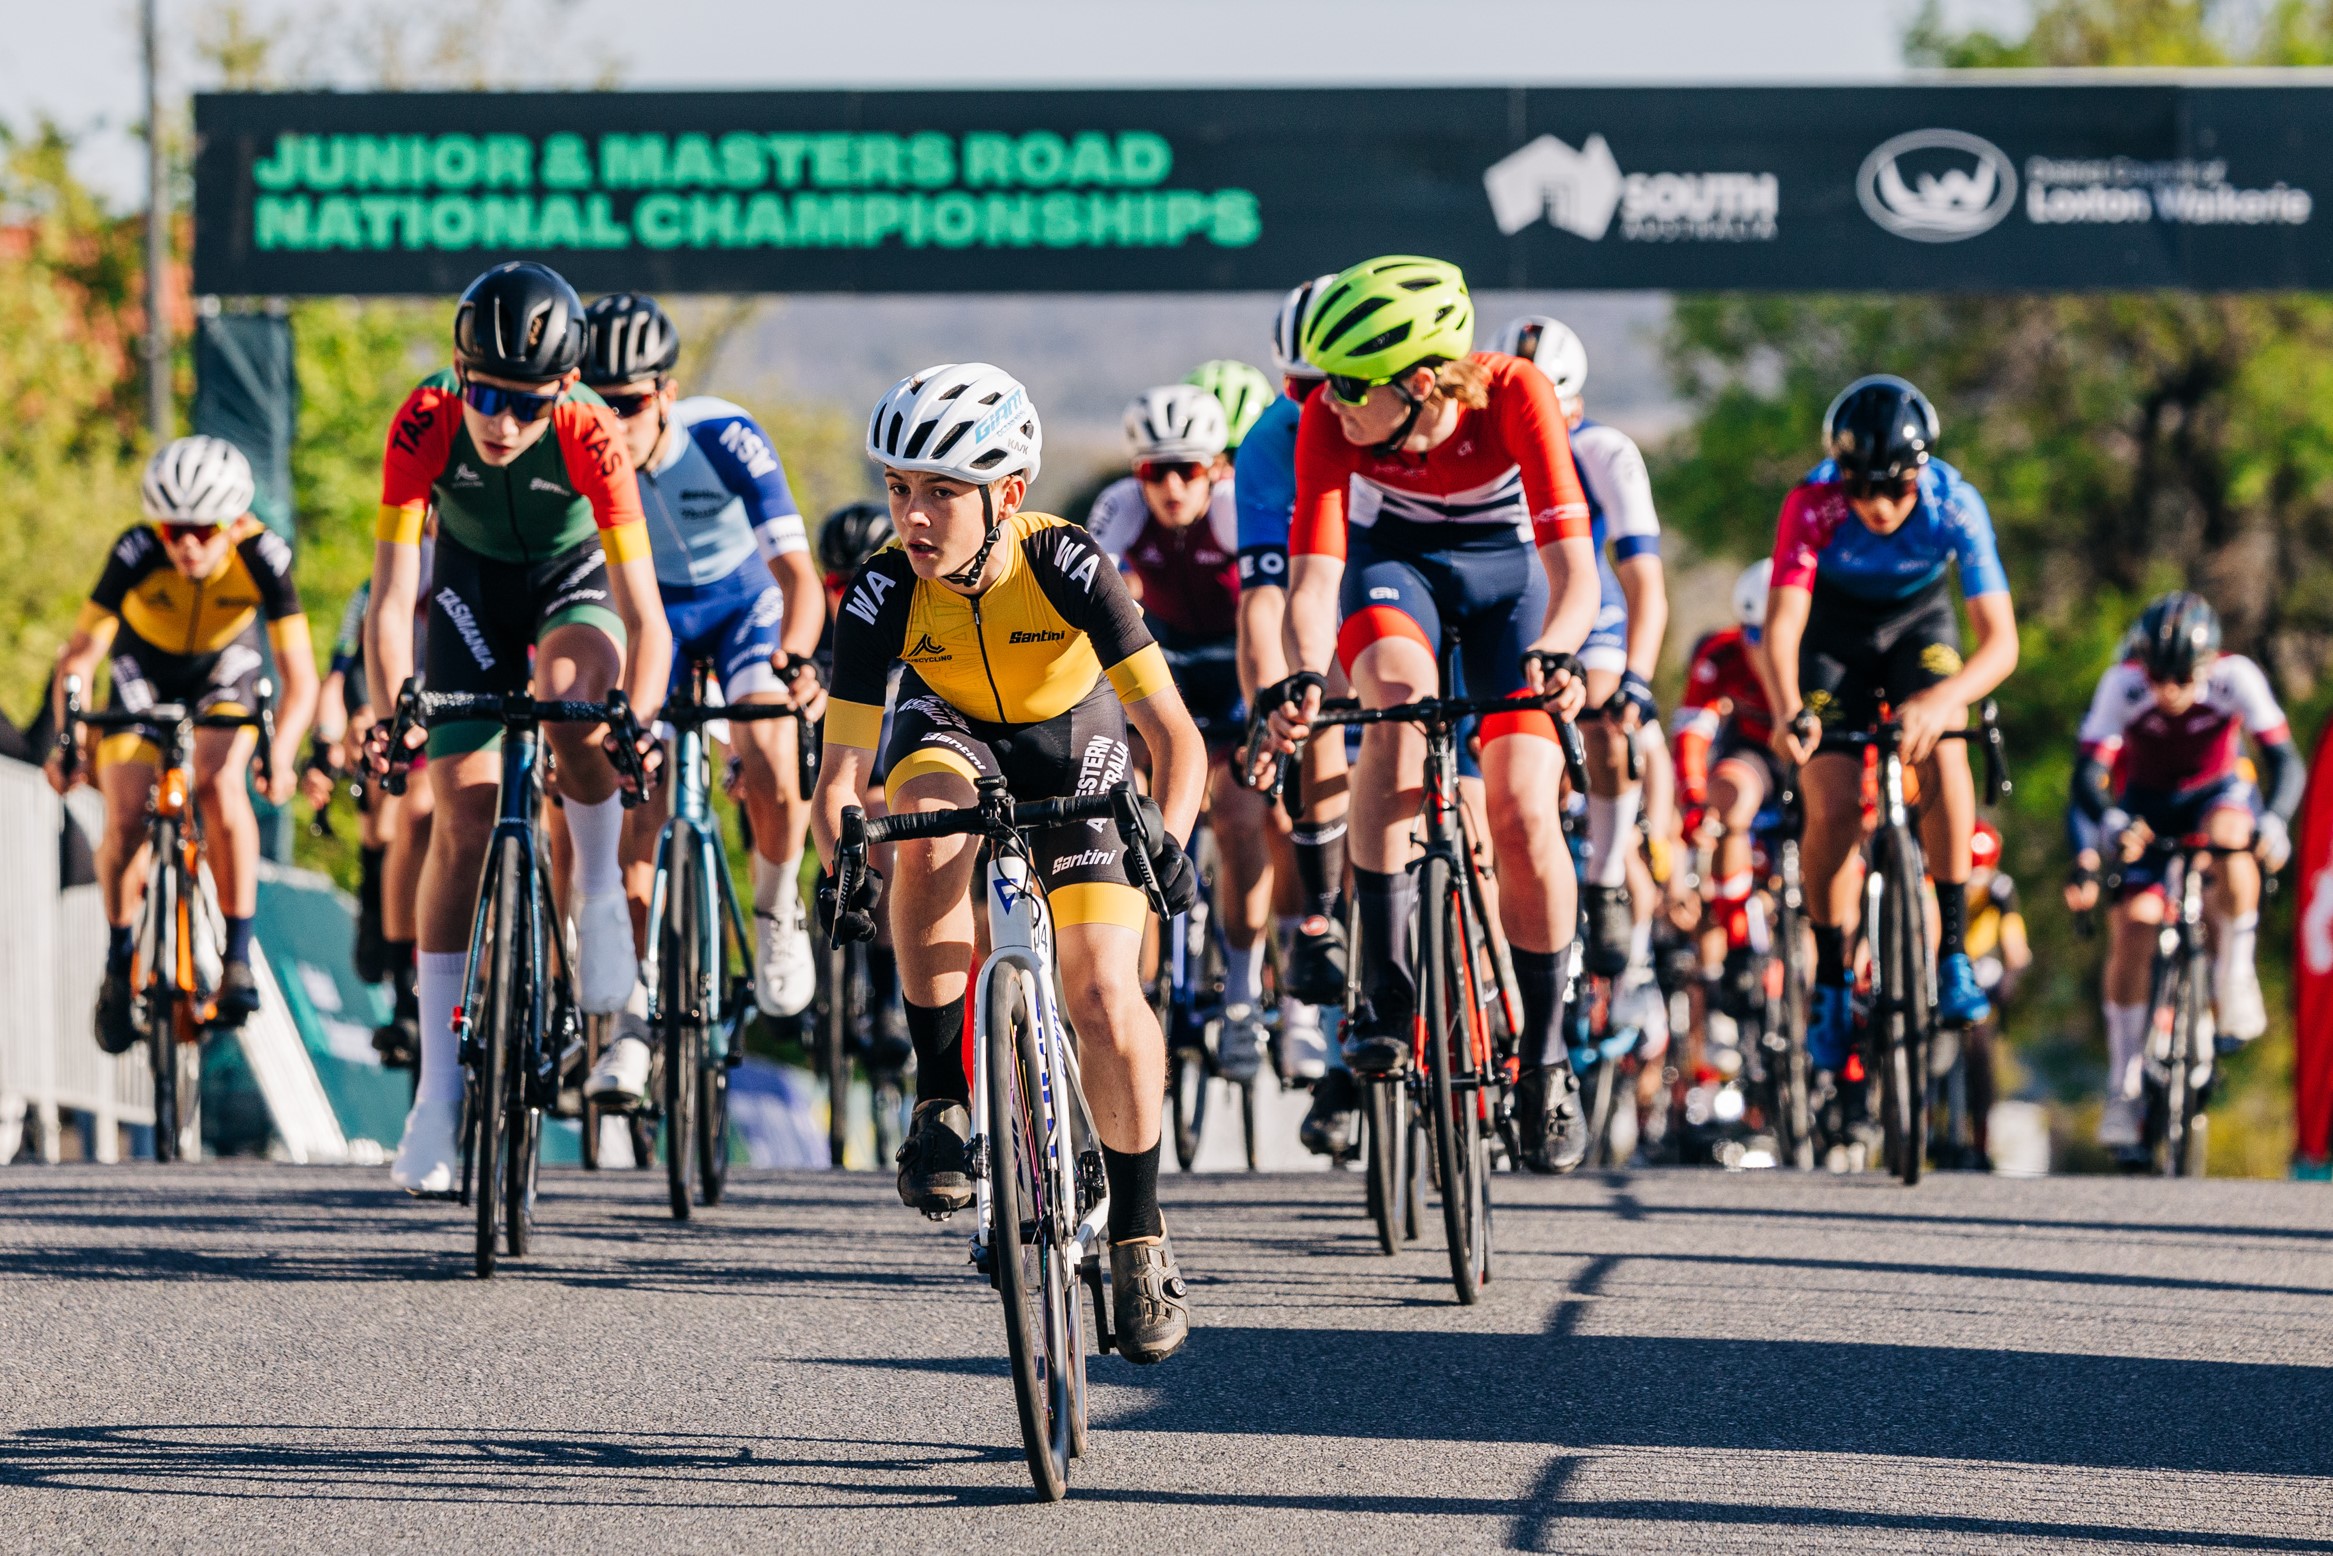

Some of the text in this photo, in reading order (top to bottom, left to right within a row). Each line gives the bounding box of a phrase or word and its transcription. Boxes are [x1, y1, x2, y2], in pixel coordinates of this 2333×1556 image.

[253, 130, 1172, 189] JUNIOR & MASTERS ROAD
[255, 189, 1261, 249] NATIONAL CHAMPIONSHIPS
[1622, 171, 1779, 221] SOUTH
[392, 400, 435, 456] TAS
[581, 417, 622, 476] TAS
[719, 420, 777, 479] NSW
[1053, 535, 1100, 594] WA
[845, 570, 896, 626] WA
[435, 586, 496, 671] TASMANIA
[1009, 629, 1065, 644] Santini
[921, 732, 987, 770] Santini
[1051, 848, 1117, 876] Santini
